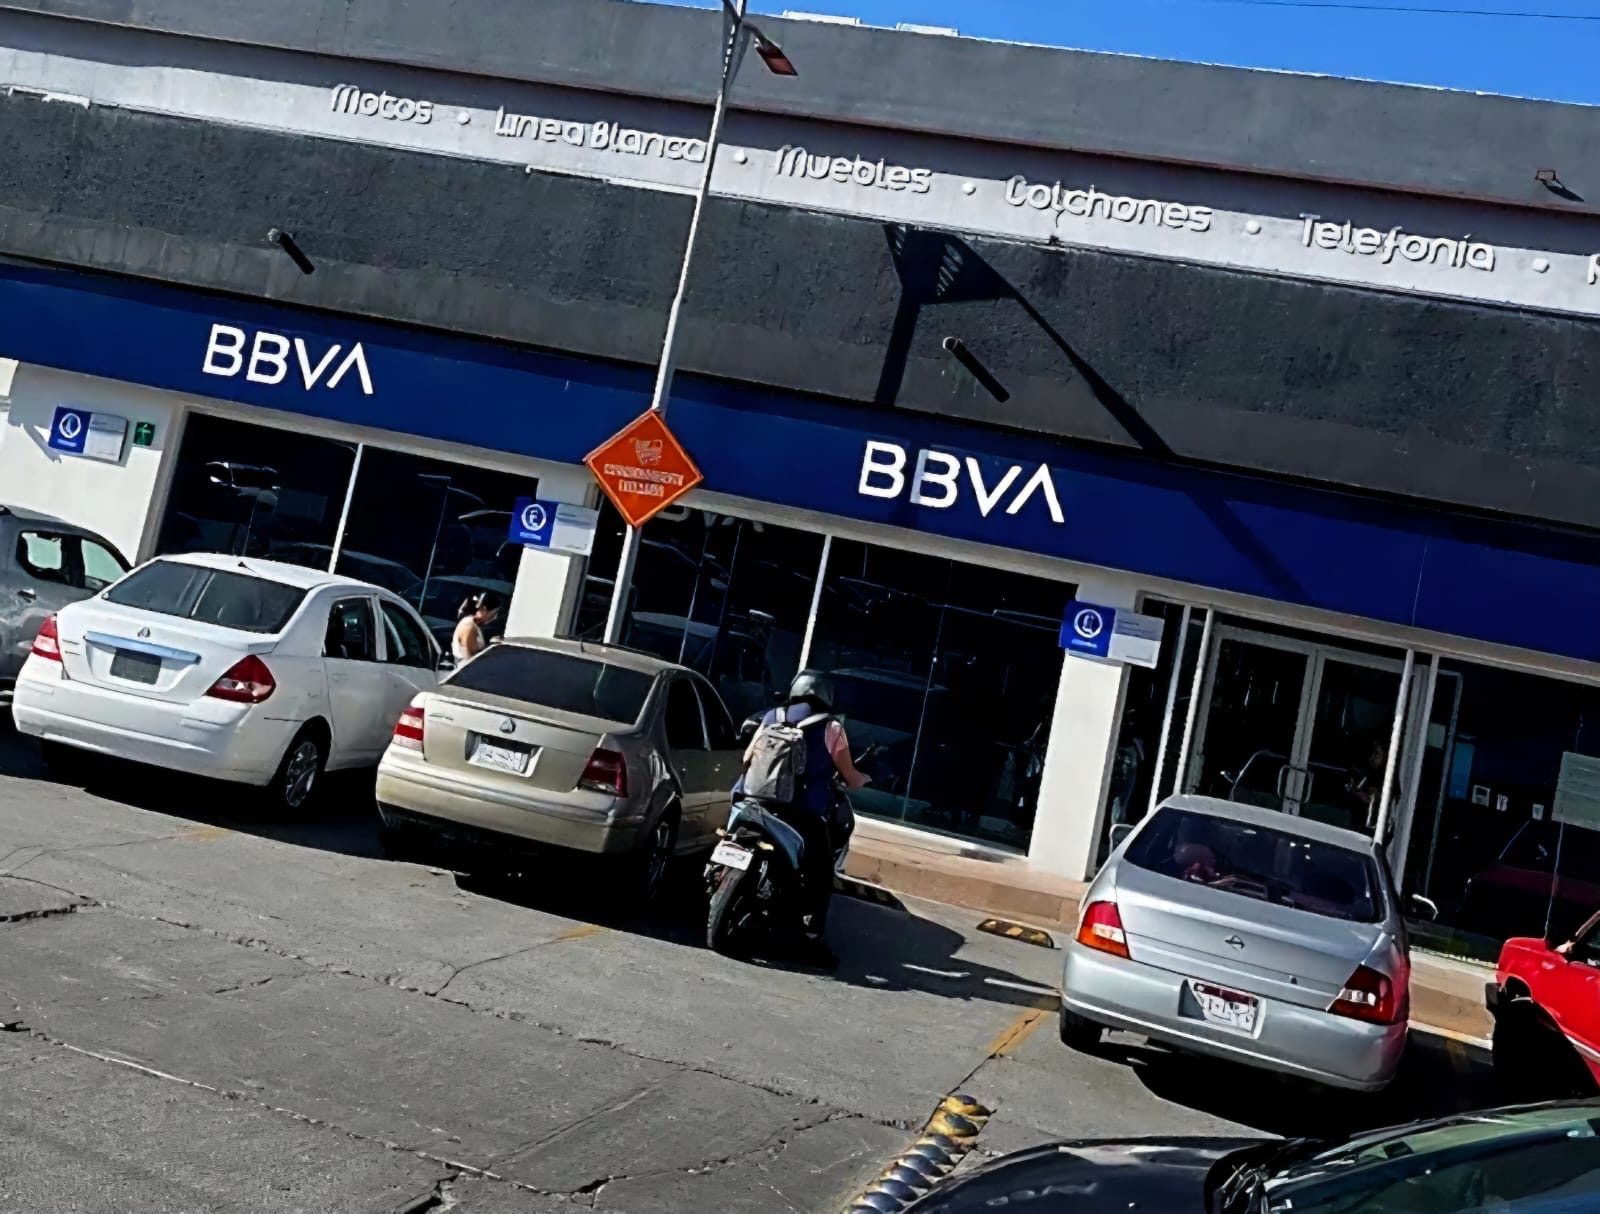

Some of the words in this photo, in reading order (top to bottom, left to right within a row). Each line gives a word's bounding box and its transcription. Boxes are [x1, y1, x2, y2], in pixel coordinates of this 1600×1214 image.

[331, 83, 433, 124] Motos
[774, 144, 932, 194] Muebles
[1005, 174, 1213, 233] Colchones
[1299, 213, 1495, 272] Telefonía
[202, 323, 374, 395] BBVA
[858, 440, 1065, 523] BBVA
